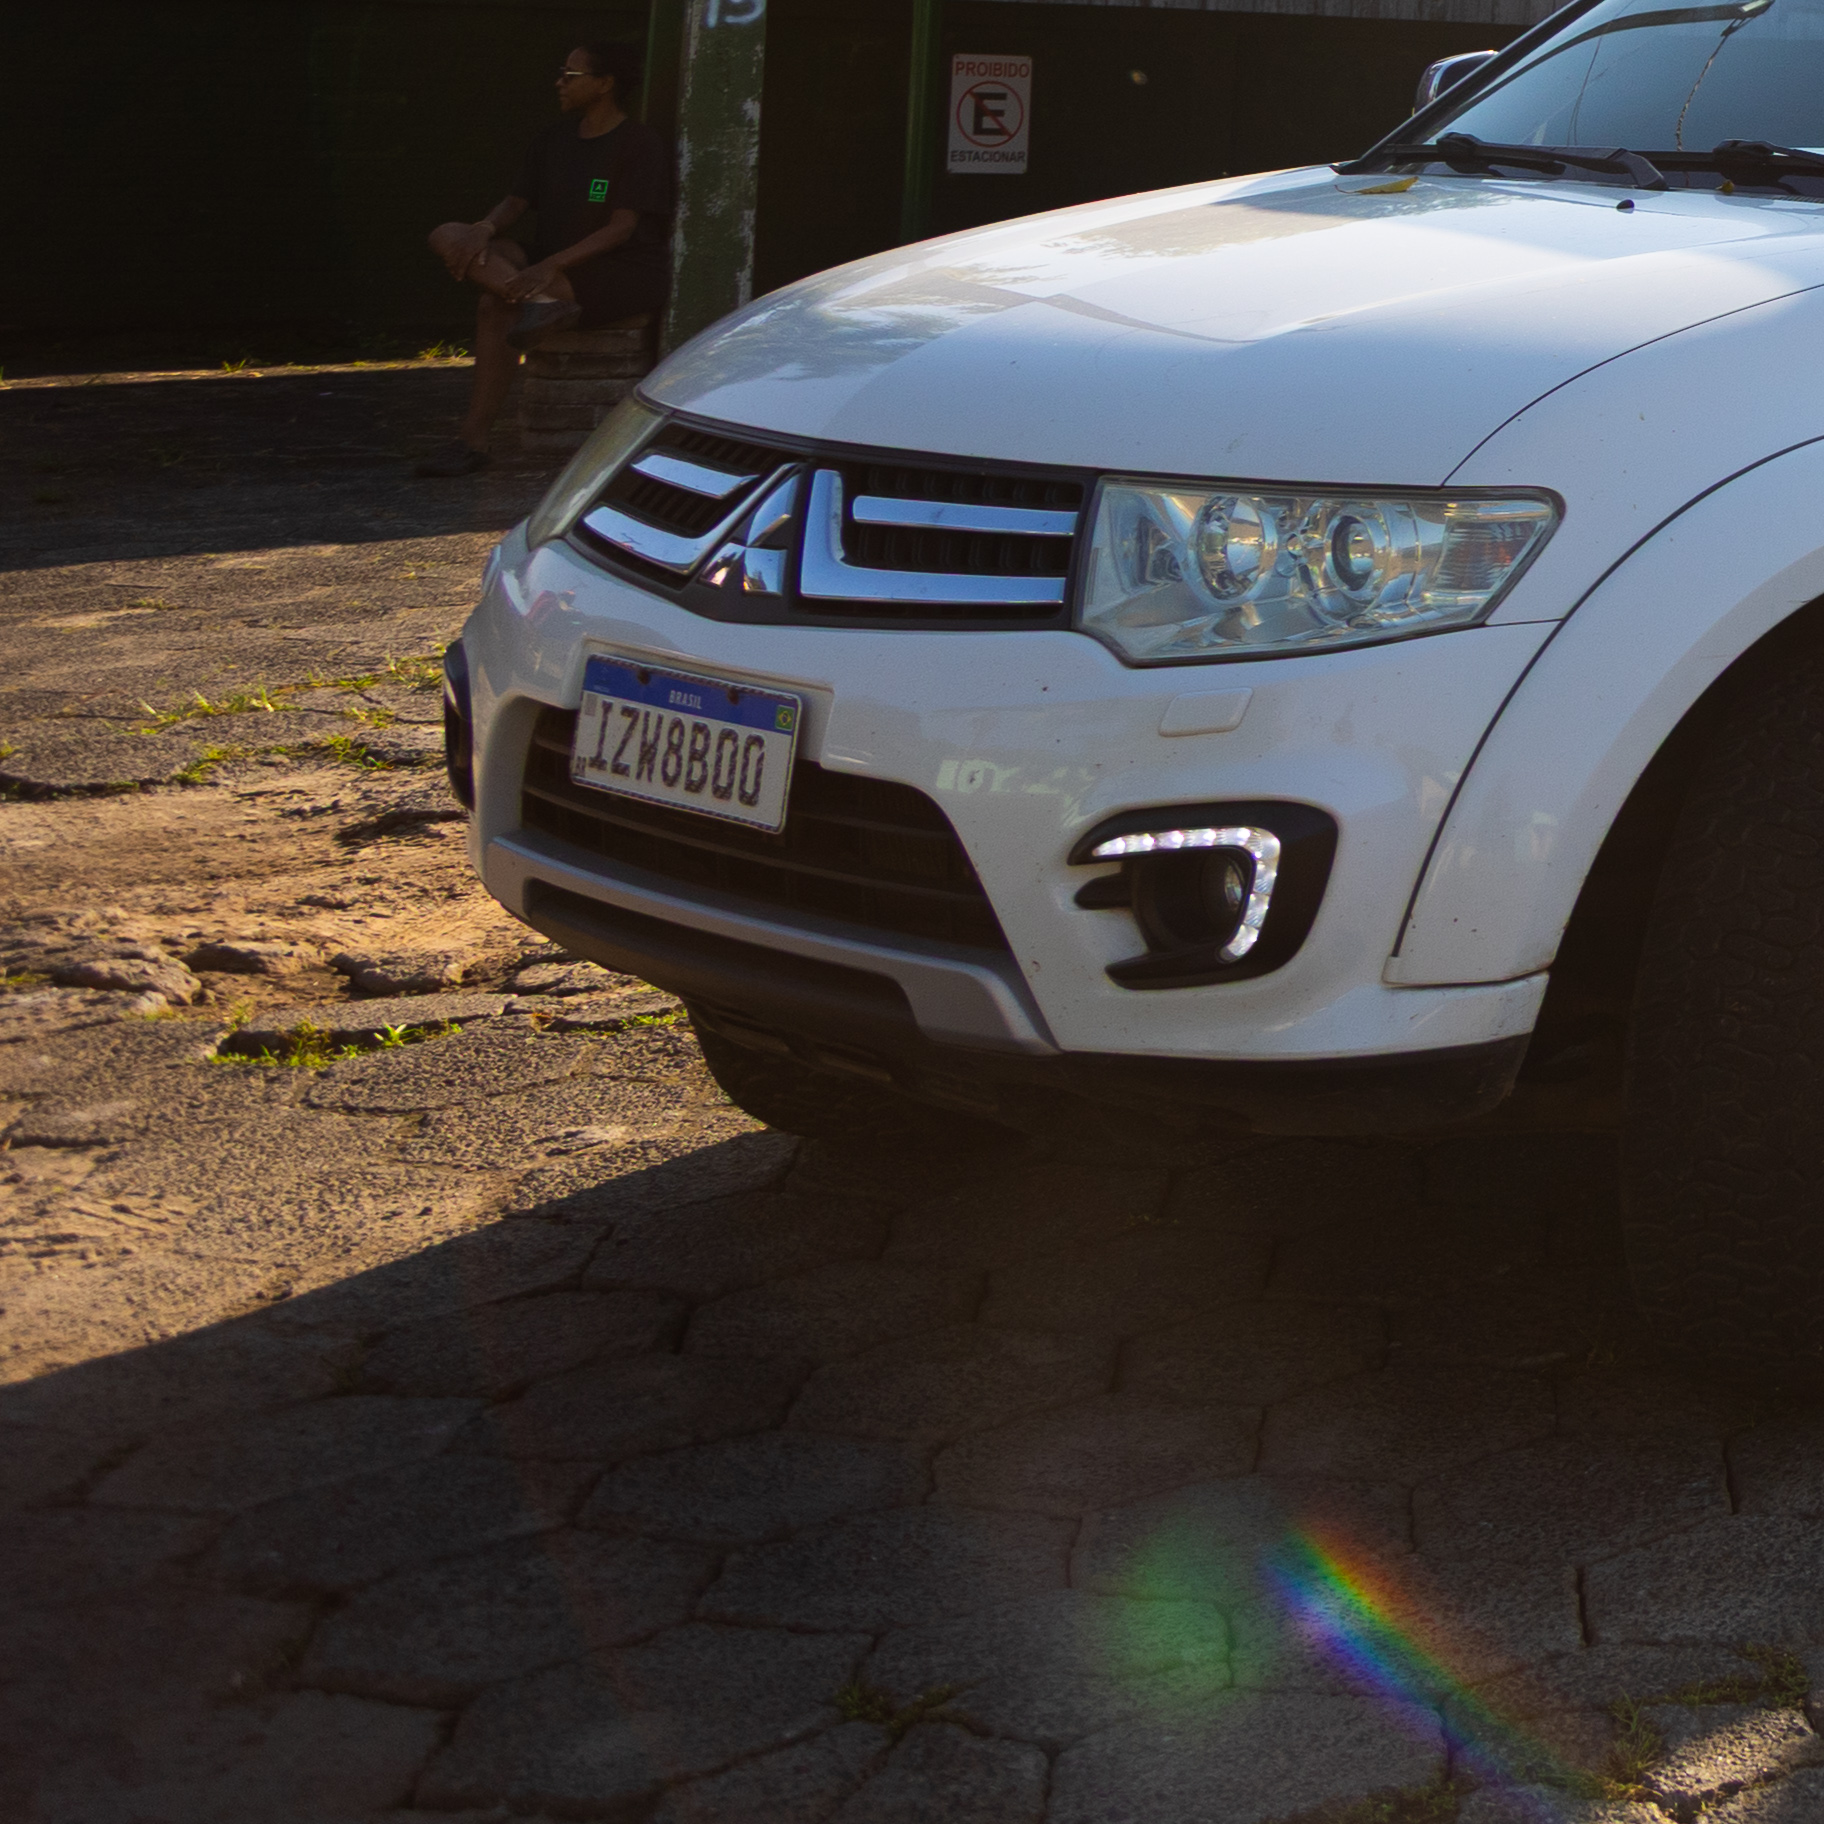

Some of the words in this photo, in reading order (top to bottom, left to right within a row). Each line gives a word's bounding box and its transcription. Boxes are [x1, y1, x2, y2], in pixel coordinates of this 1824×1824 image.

[954, 61, 1030, 78] PROIBIDO
[950, 150, 1026, 163] ESTACIONAR
[668, 689, 703, 710] BRASIL
